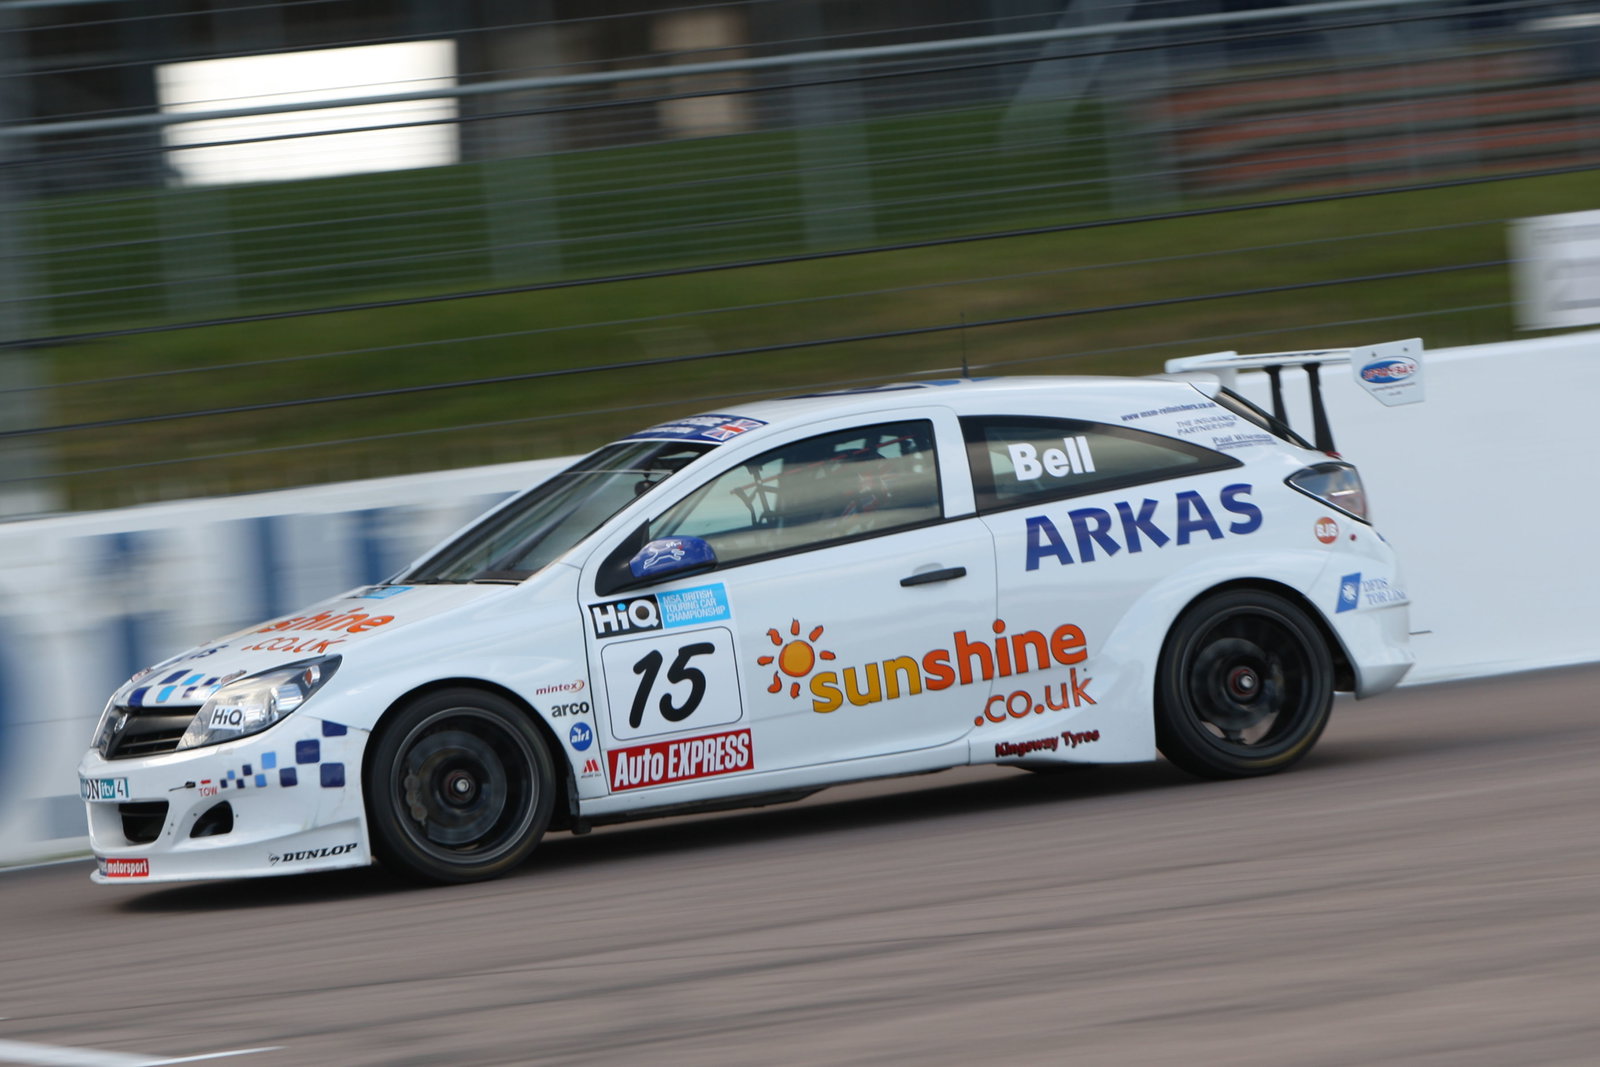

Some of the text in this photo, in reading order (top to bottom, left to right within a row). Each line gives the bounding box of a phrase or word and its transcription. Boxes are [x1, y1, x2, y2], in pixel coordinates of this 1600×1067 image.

[1007, 436, 1096, 481] Bell
[1025, 483, 1264, 572] ARKAS
[663, 588, 713, 605] MSA BRITISH
[666, 598, 717, 613] TOURING CAR
[592, 599, 660, 635] HiQ
[667, 605, 726, 622] CHAMPIONSHIP
[809, 619, 1088, 713] sunshine
[536, 683, 578, 696] mintex
[629, 642, 716, 729] 15
[974, 668, 1098, 727] .co.uk
[212, 708, 243, 727] HiQ
[551, 701, 590, 718] arco
[1061, 730, 1100, 749] Tyres
[613, 732, 750, 788] Auto EXPRESS
[198, 787, 218, 797] TOW
[282, 843, 358, 862] DUNLOP
[107, 860, 148, 877] motorsport
